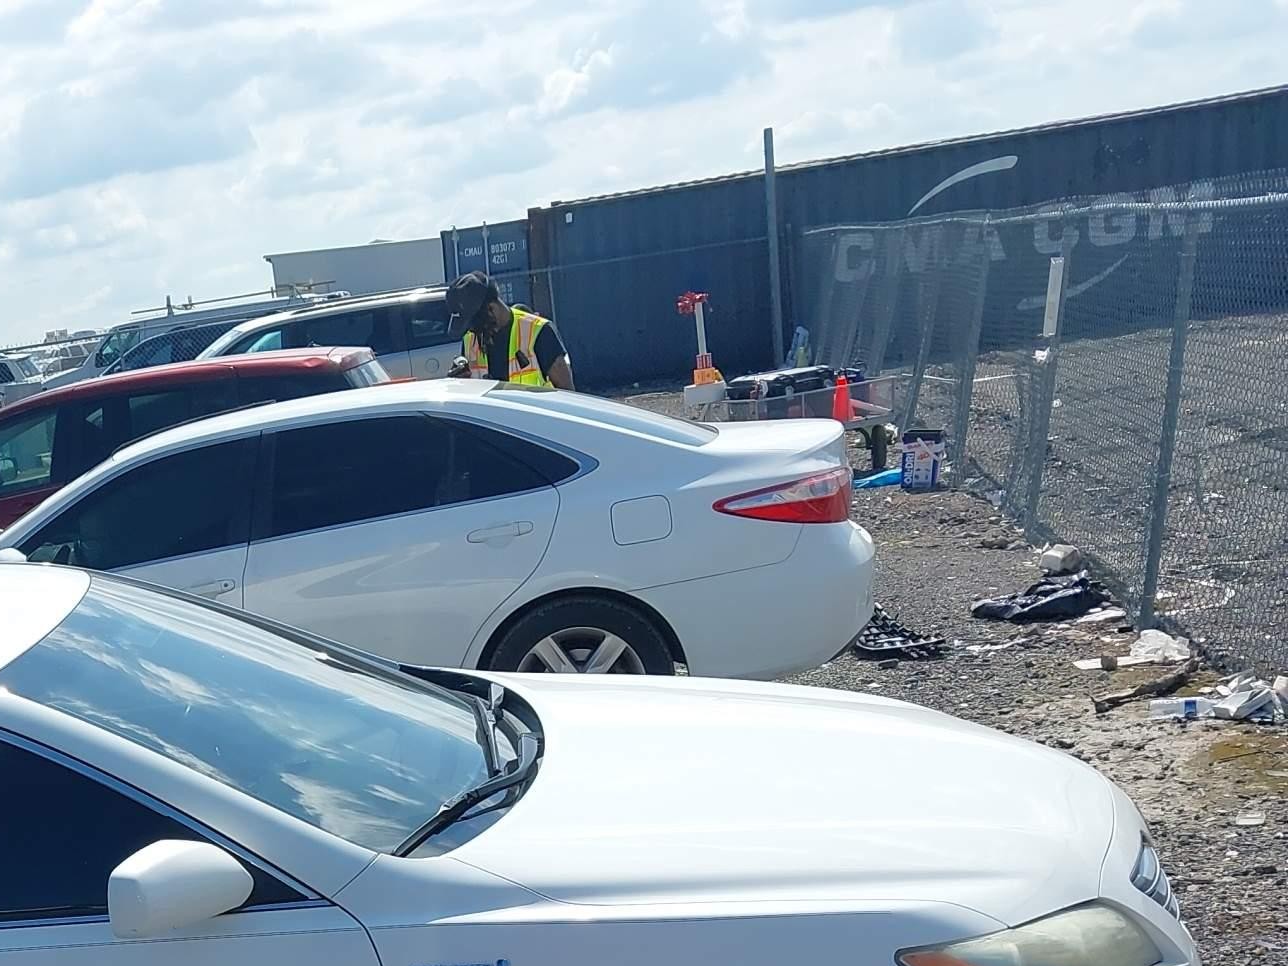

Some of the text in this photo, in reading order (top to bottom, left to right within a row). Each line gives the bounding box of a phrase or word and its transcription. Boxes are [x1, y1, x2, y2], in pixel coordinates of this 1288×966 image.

[1033, 181, 1213, 254] CGM
[464, 246, 483, 257] CMAU
[490, 241, 516, 254] 803073
